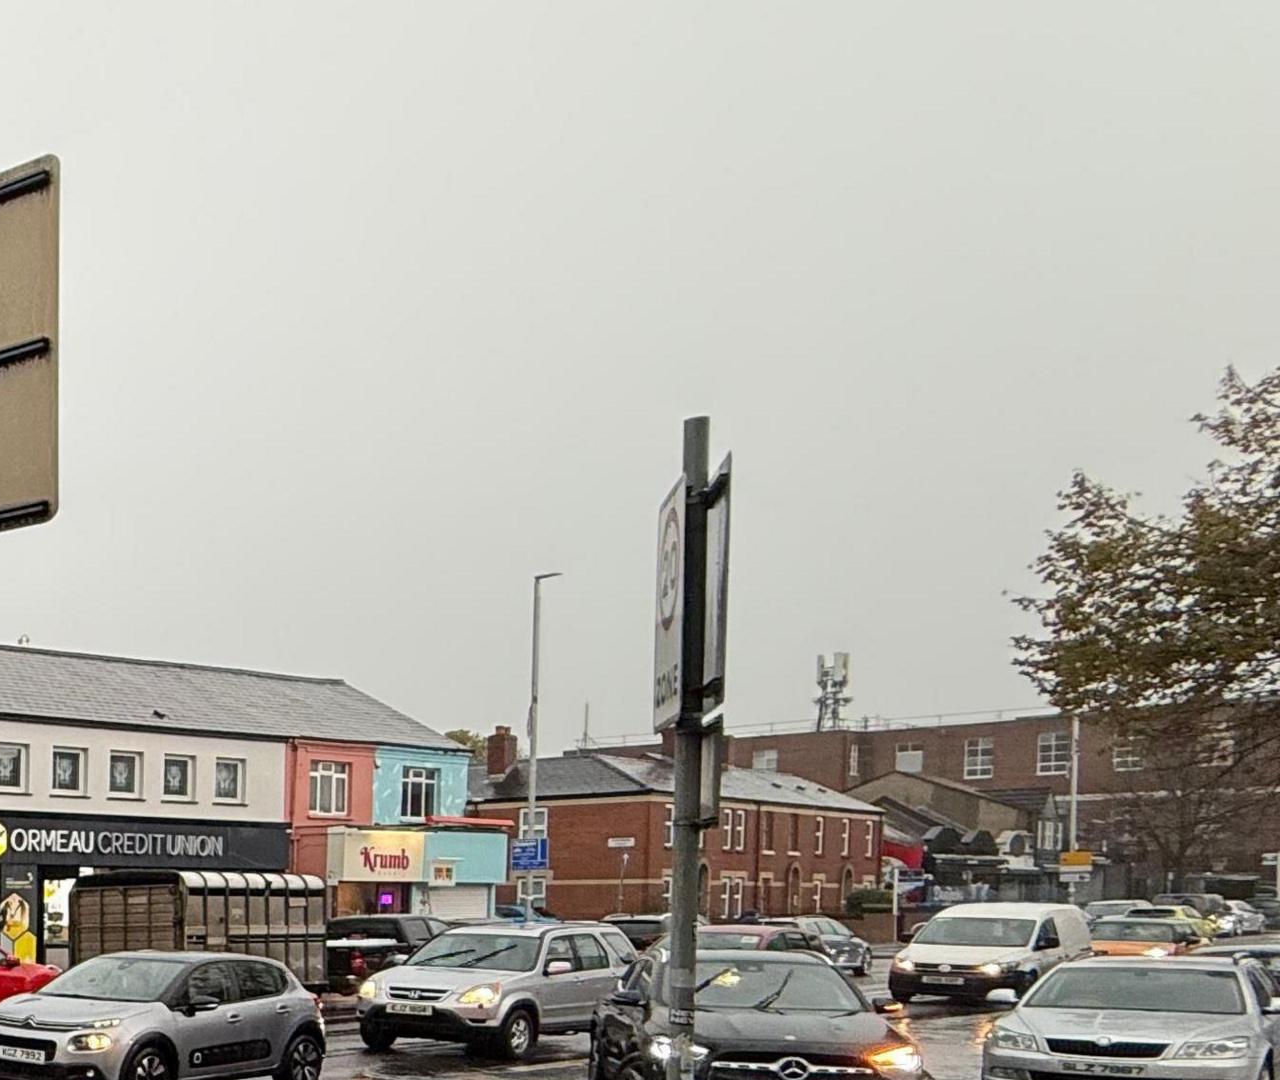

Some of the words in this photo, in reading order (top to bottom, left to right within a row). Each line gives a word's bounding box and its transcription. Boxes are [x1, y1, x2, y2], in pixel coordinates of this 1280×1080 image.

[656, 663, 678, 710] ZONE
[10, 828, 95, 854] ORMEAU
[96, 831, 166, 856] CREDIT
[166, 834, 224, 857] UNION
[360, 846, 410, 873] Krumb
